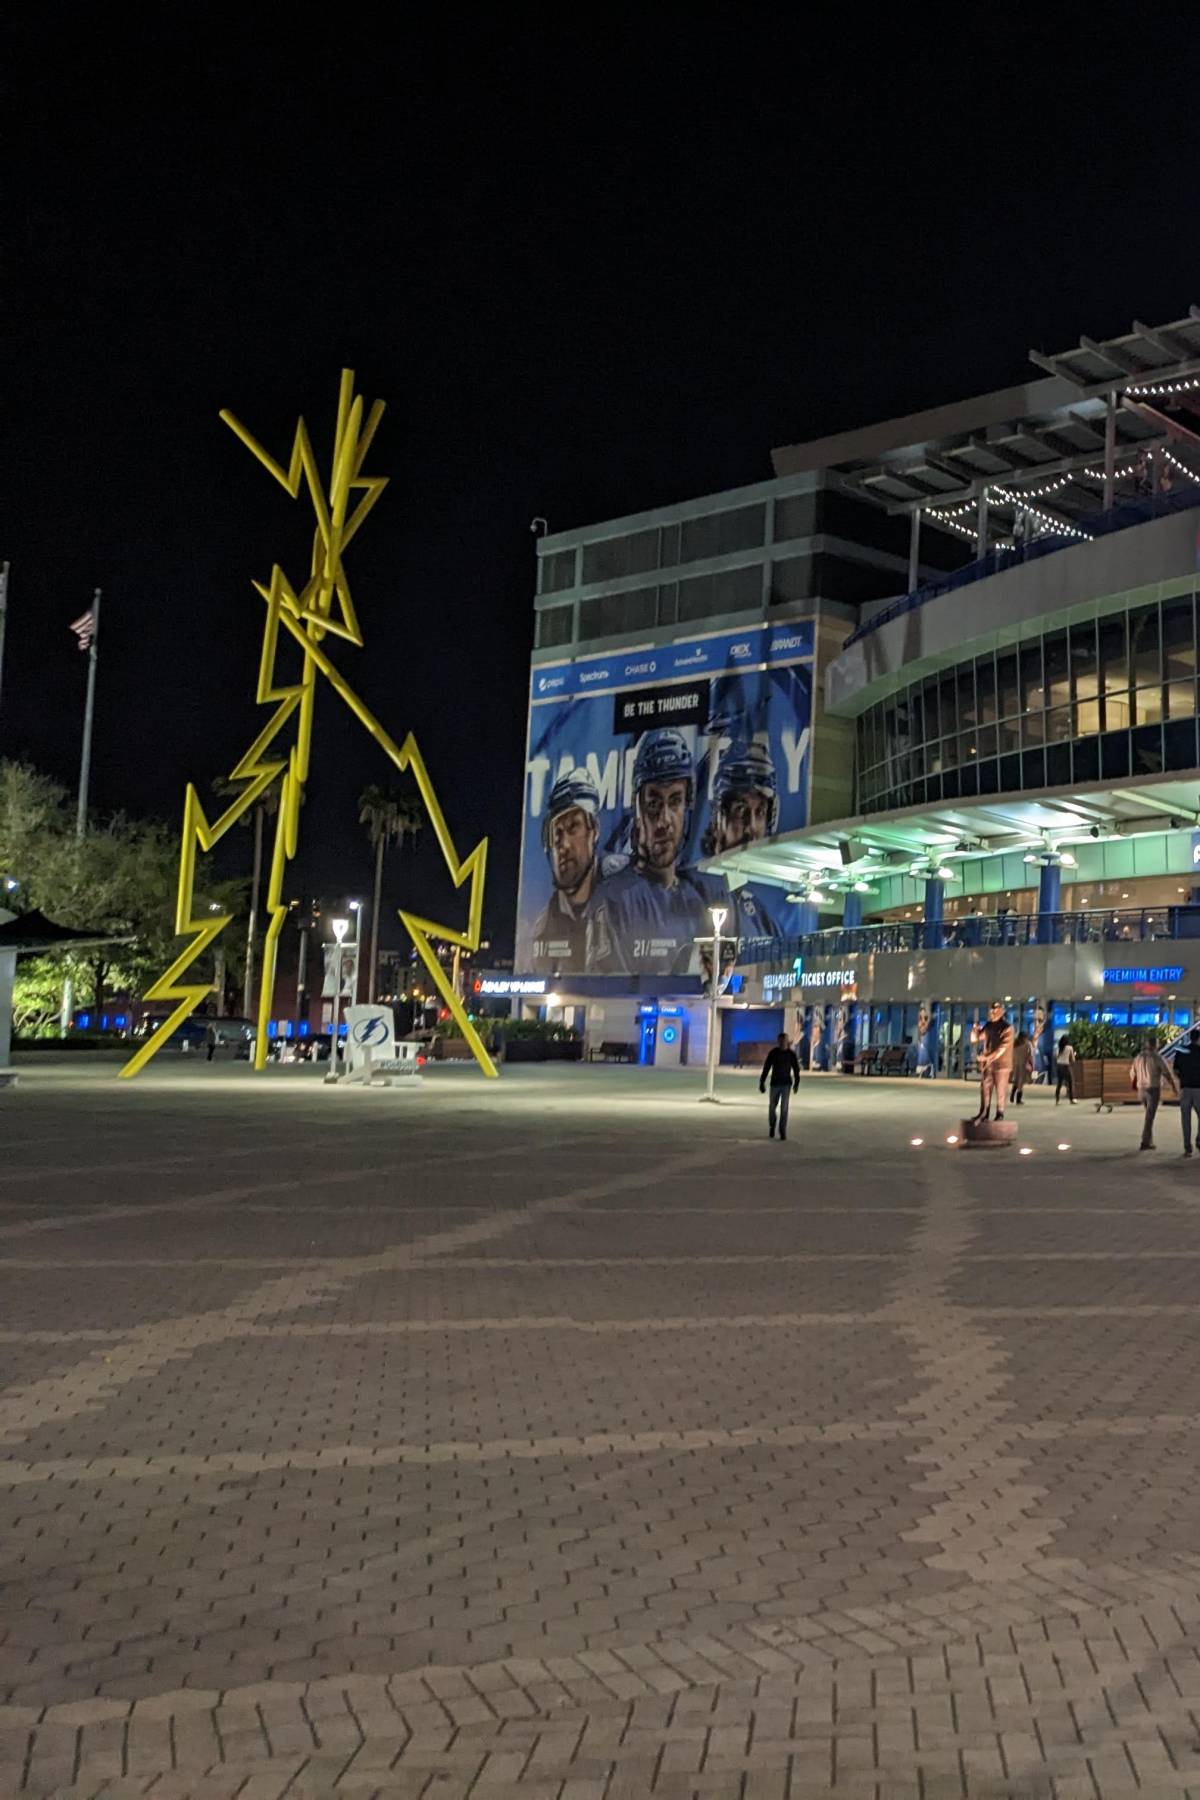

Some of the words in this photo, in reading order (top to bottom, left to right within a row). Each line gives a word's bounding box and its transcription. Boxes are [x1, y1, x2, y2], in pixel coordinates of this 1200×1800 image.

[625, 662, 649, 675] CHASE
[624, 703, 636, 717] BE
[638, 700, 655, 715] THE
[657, 695, 699, 713] THUNDER
[801, 972, 825, 987] TICKET
[826, 970, 855, 986] OFFICE
[1103, 970, 1147, 981] PREMIUM
[1150, 967, 1184, 980] ENTRY
